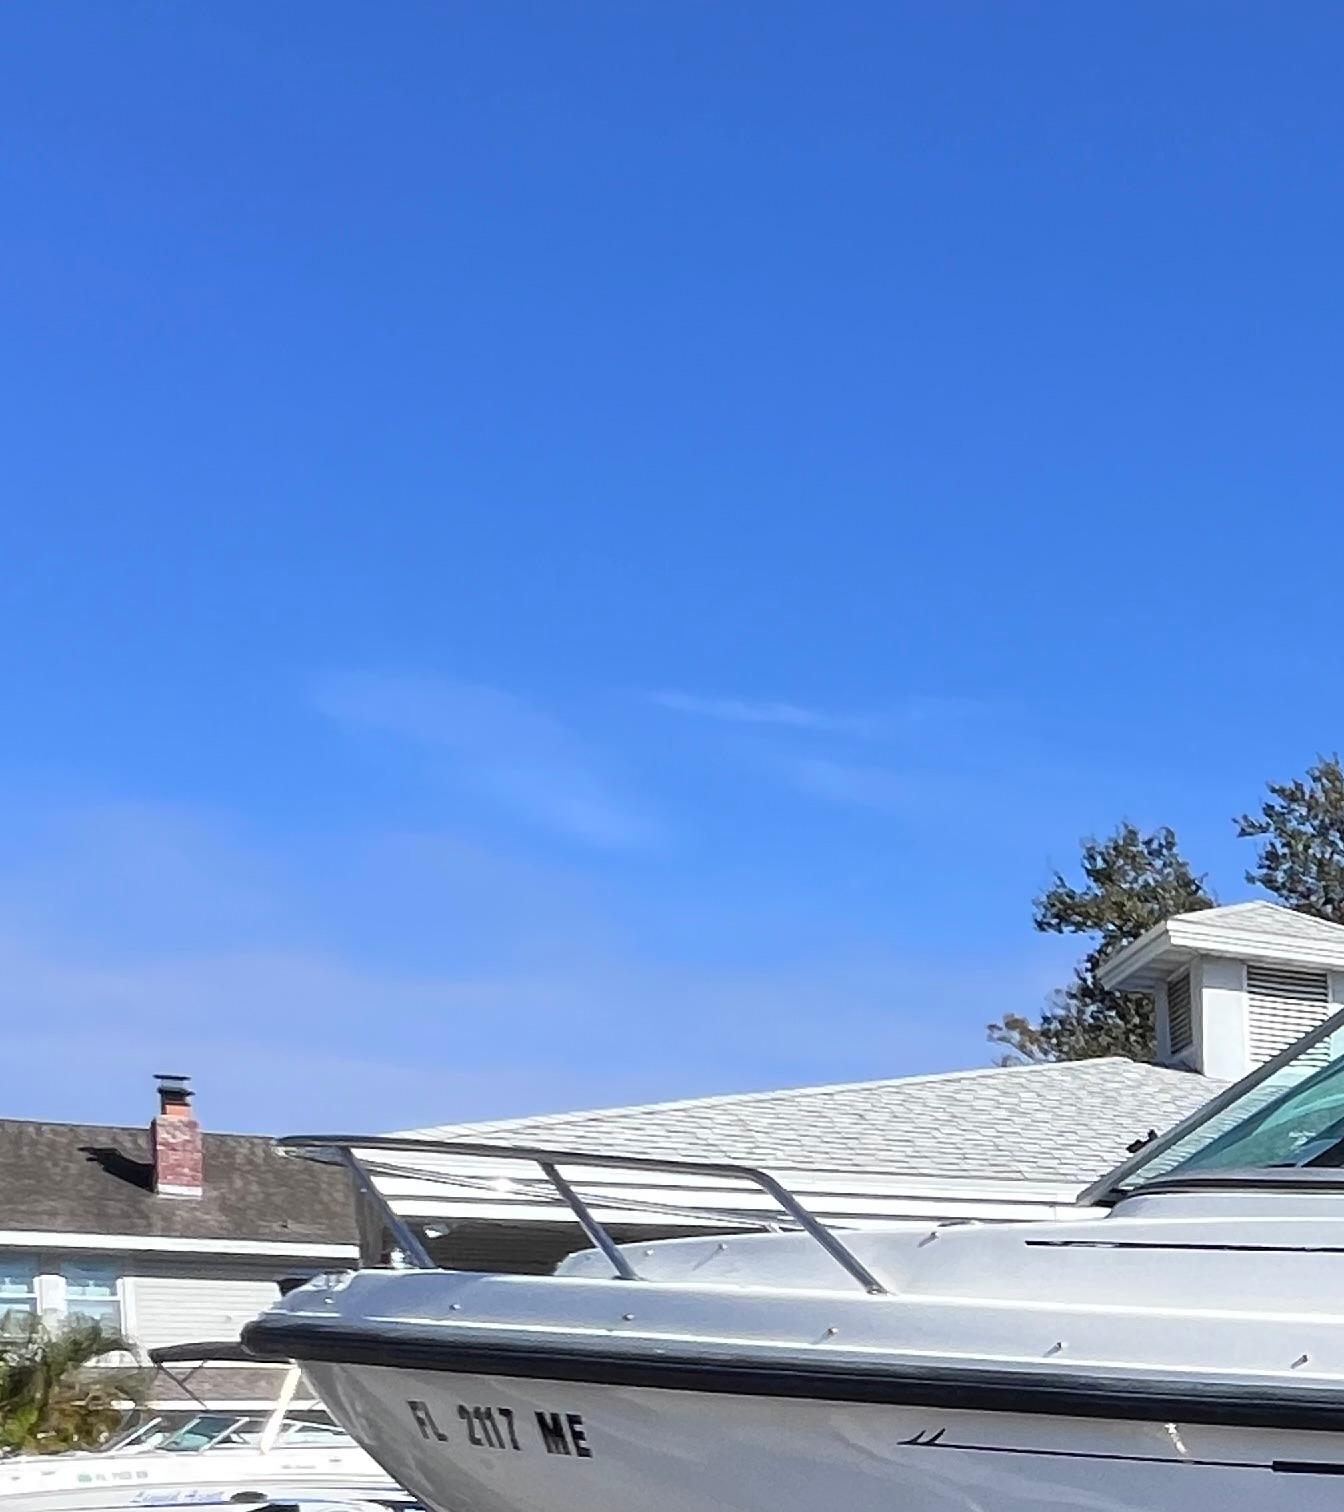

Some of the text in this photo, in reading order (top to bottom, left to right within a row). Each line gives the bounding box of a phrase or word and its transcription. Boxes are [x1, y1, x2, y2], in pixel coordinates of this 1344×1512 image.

[407, 1400, 593, 1458] FL 2117 ME
